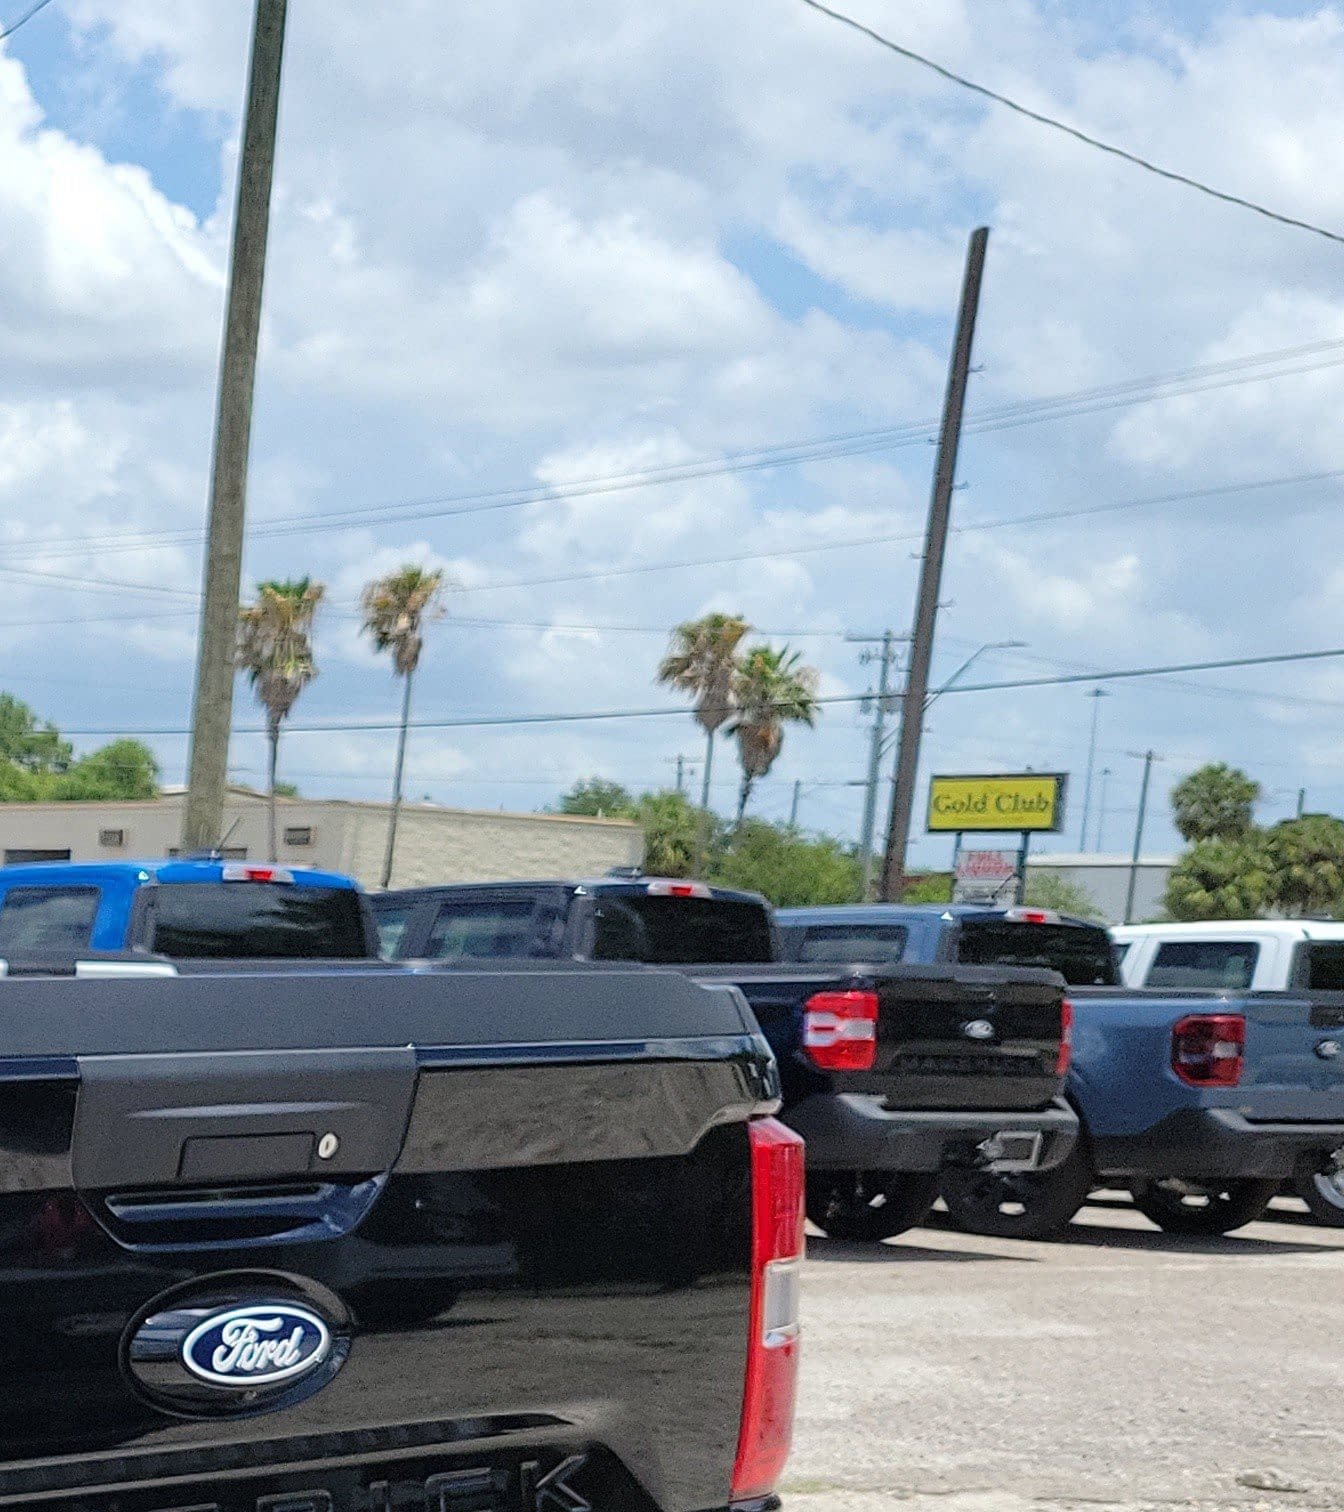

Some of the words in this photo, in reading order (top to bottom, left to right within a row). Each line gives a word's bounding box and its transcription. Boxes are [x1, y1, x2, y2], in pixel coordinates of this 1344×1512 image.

[933, 793, 988, 814] Gold
[996, 792, 1050, 814] Club
[212, 1317, 305, 1373] Ford
